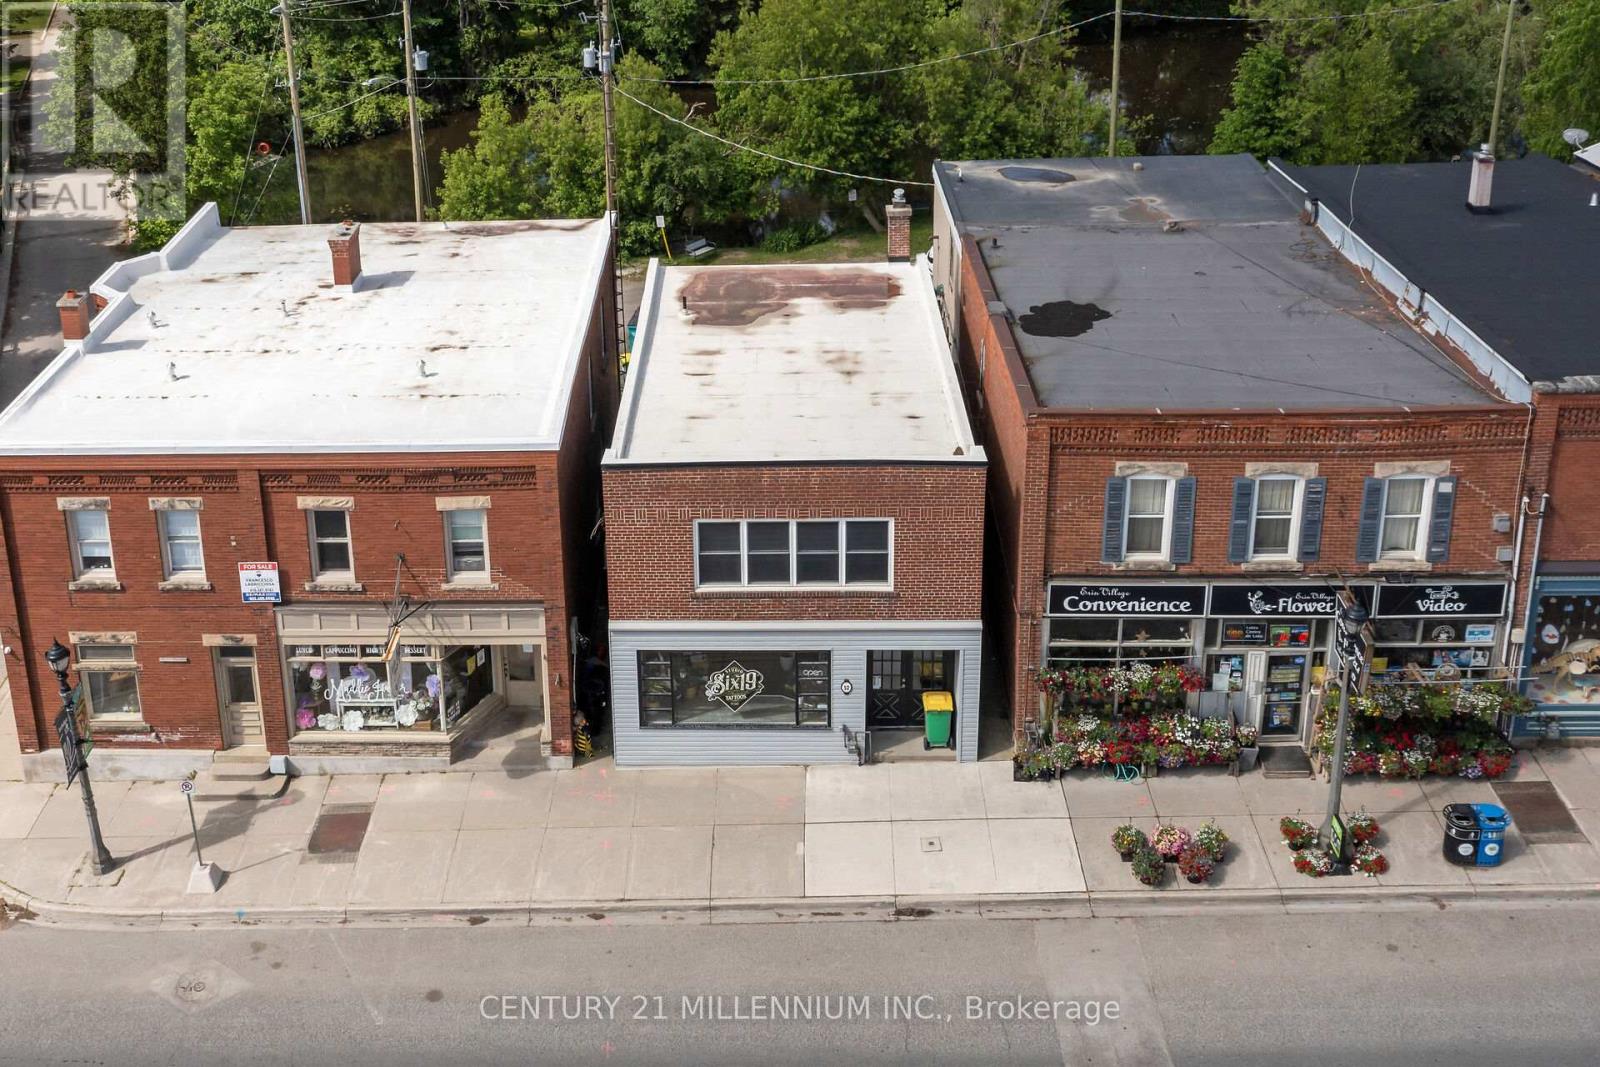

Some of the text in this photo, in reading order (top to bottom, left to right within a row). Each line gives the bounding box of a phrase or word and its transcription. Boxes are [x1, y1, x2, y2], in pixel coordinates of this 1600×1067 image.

[1099, 587, 1130, 598] Village
[1063, 596, 1192, 612] Convenience
[1416, 597, 1467, 612] Video
[711, 672, 756, 695] Six19
